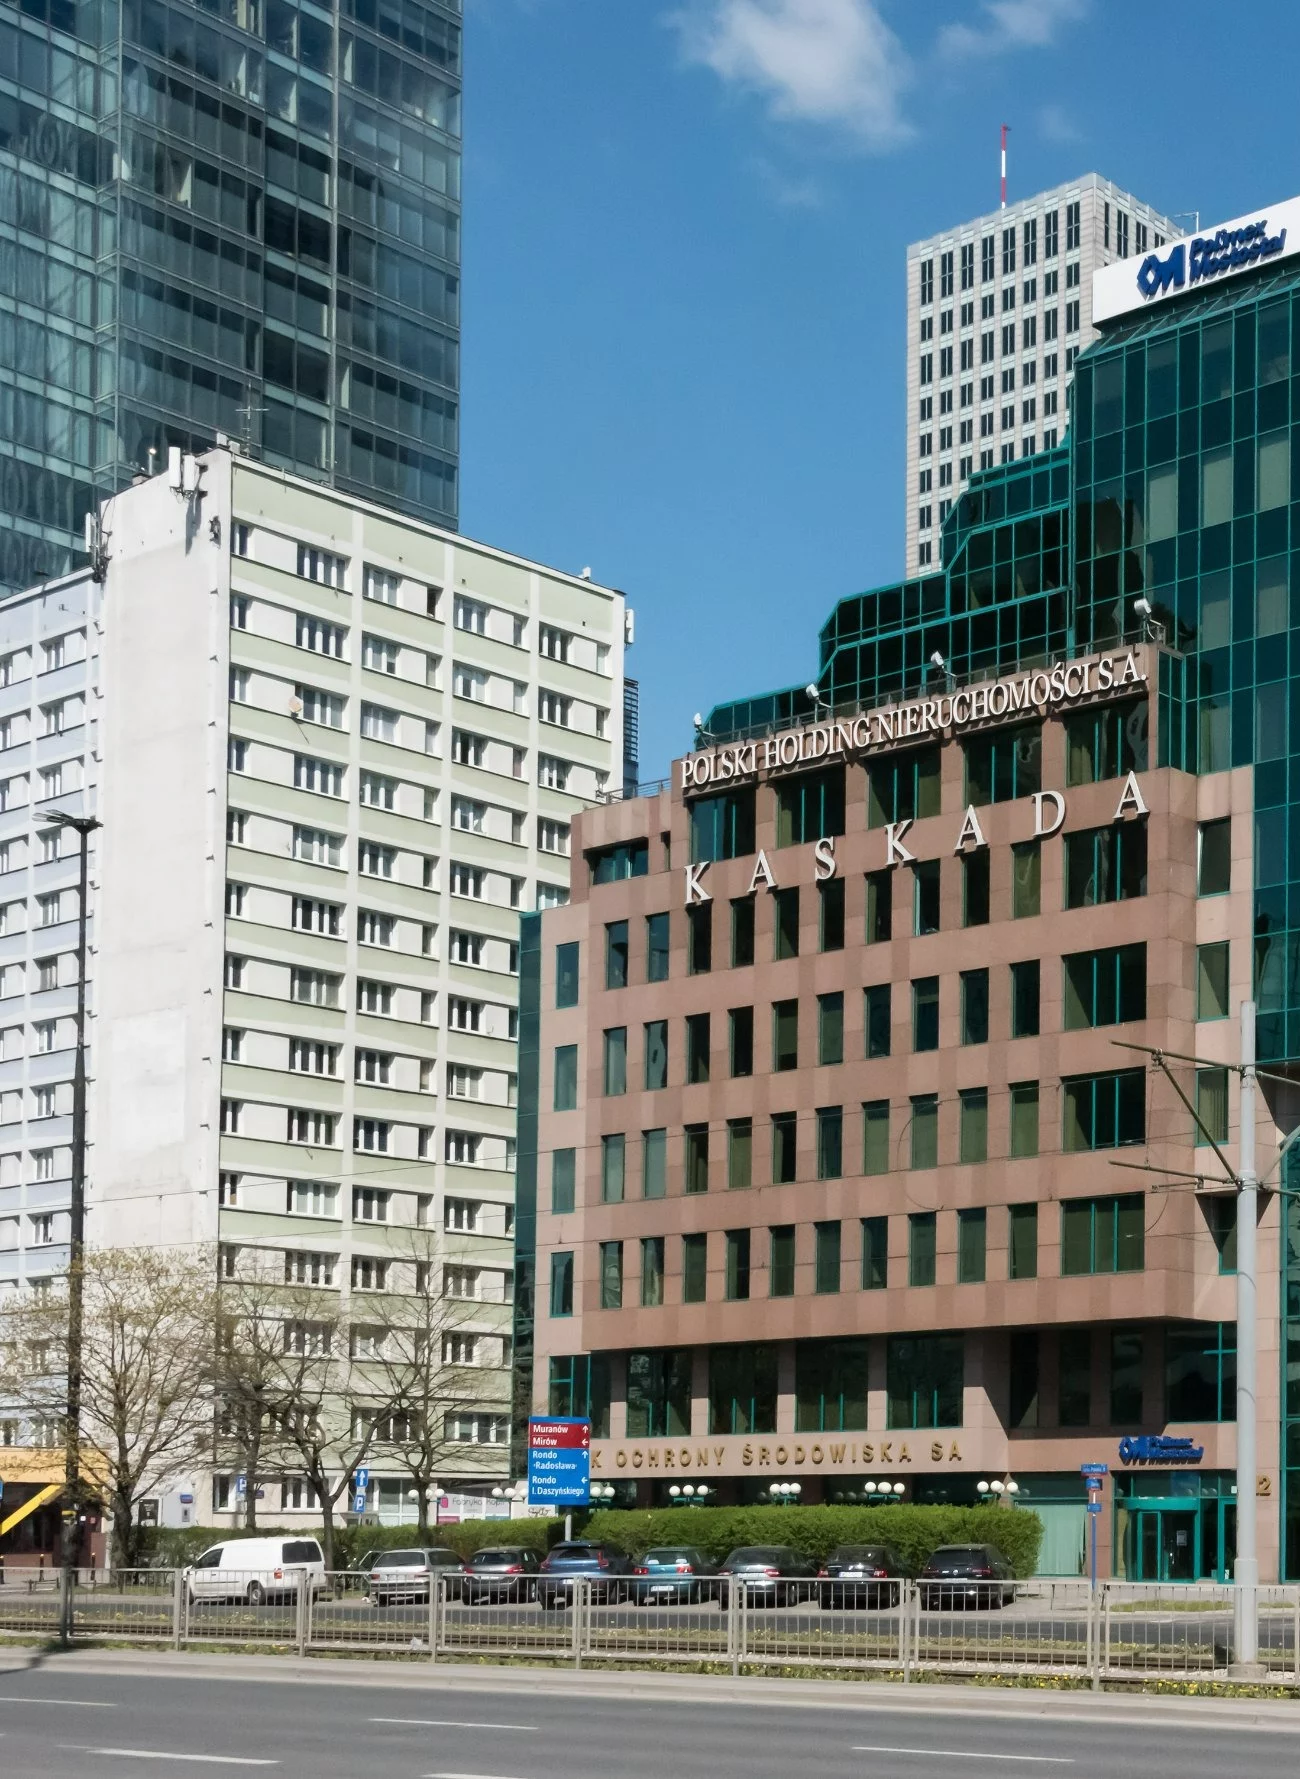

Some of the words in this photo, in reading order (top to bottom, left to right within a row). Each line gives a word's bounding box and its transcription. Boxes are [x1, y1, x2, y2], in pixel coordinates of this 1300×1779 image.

[681, 744, 758, 788] POLSKI
[764, 717, 872, 769] HOLDING
[877, 662, 1091, 740] NIERUCHOMOŚCI
[1098, 652, 1148, 691] S.A.
[533, 1424, 569, 1434] Muranów
[533, 1437, 558, 1446] Mirów
[532, 1450, 558, 1459] Rondo
[615, 1446, 726, 1469] OCHRONY
[742, 1439, 912, 1467] ŚRODOWISKA
[931, 1439, 963, 1463] SA
[532, 1475, 557, 1484] Rondo
